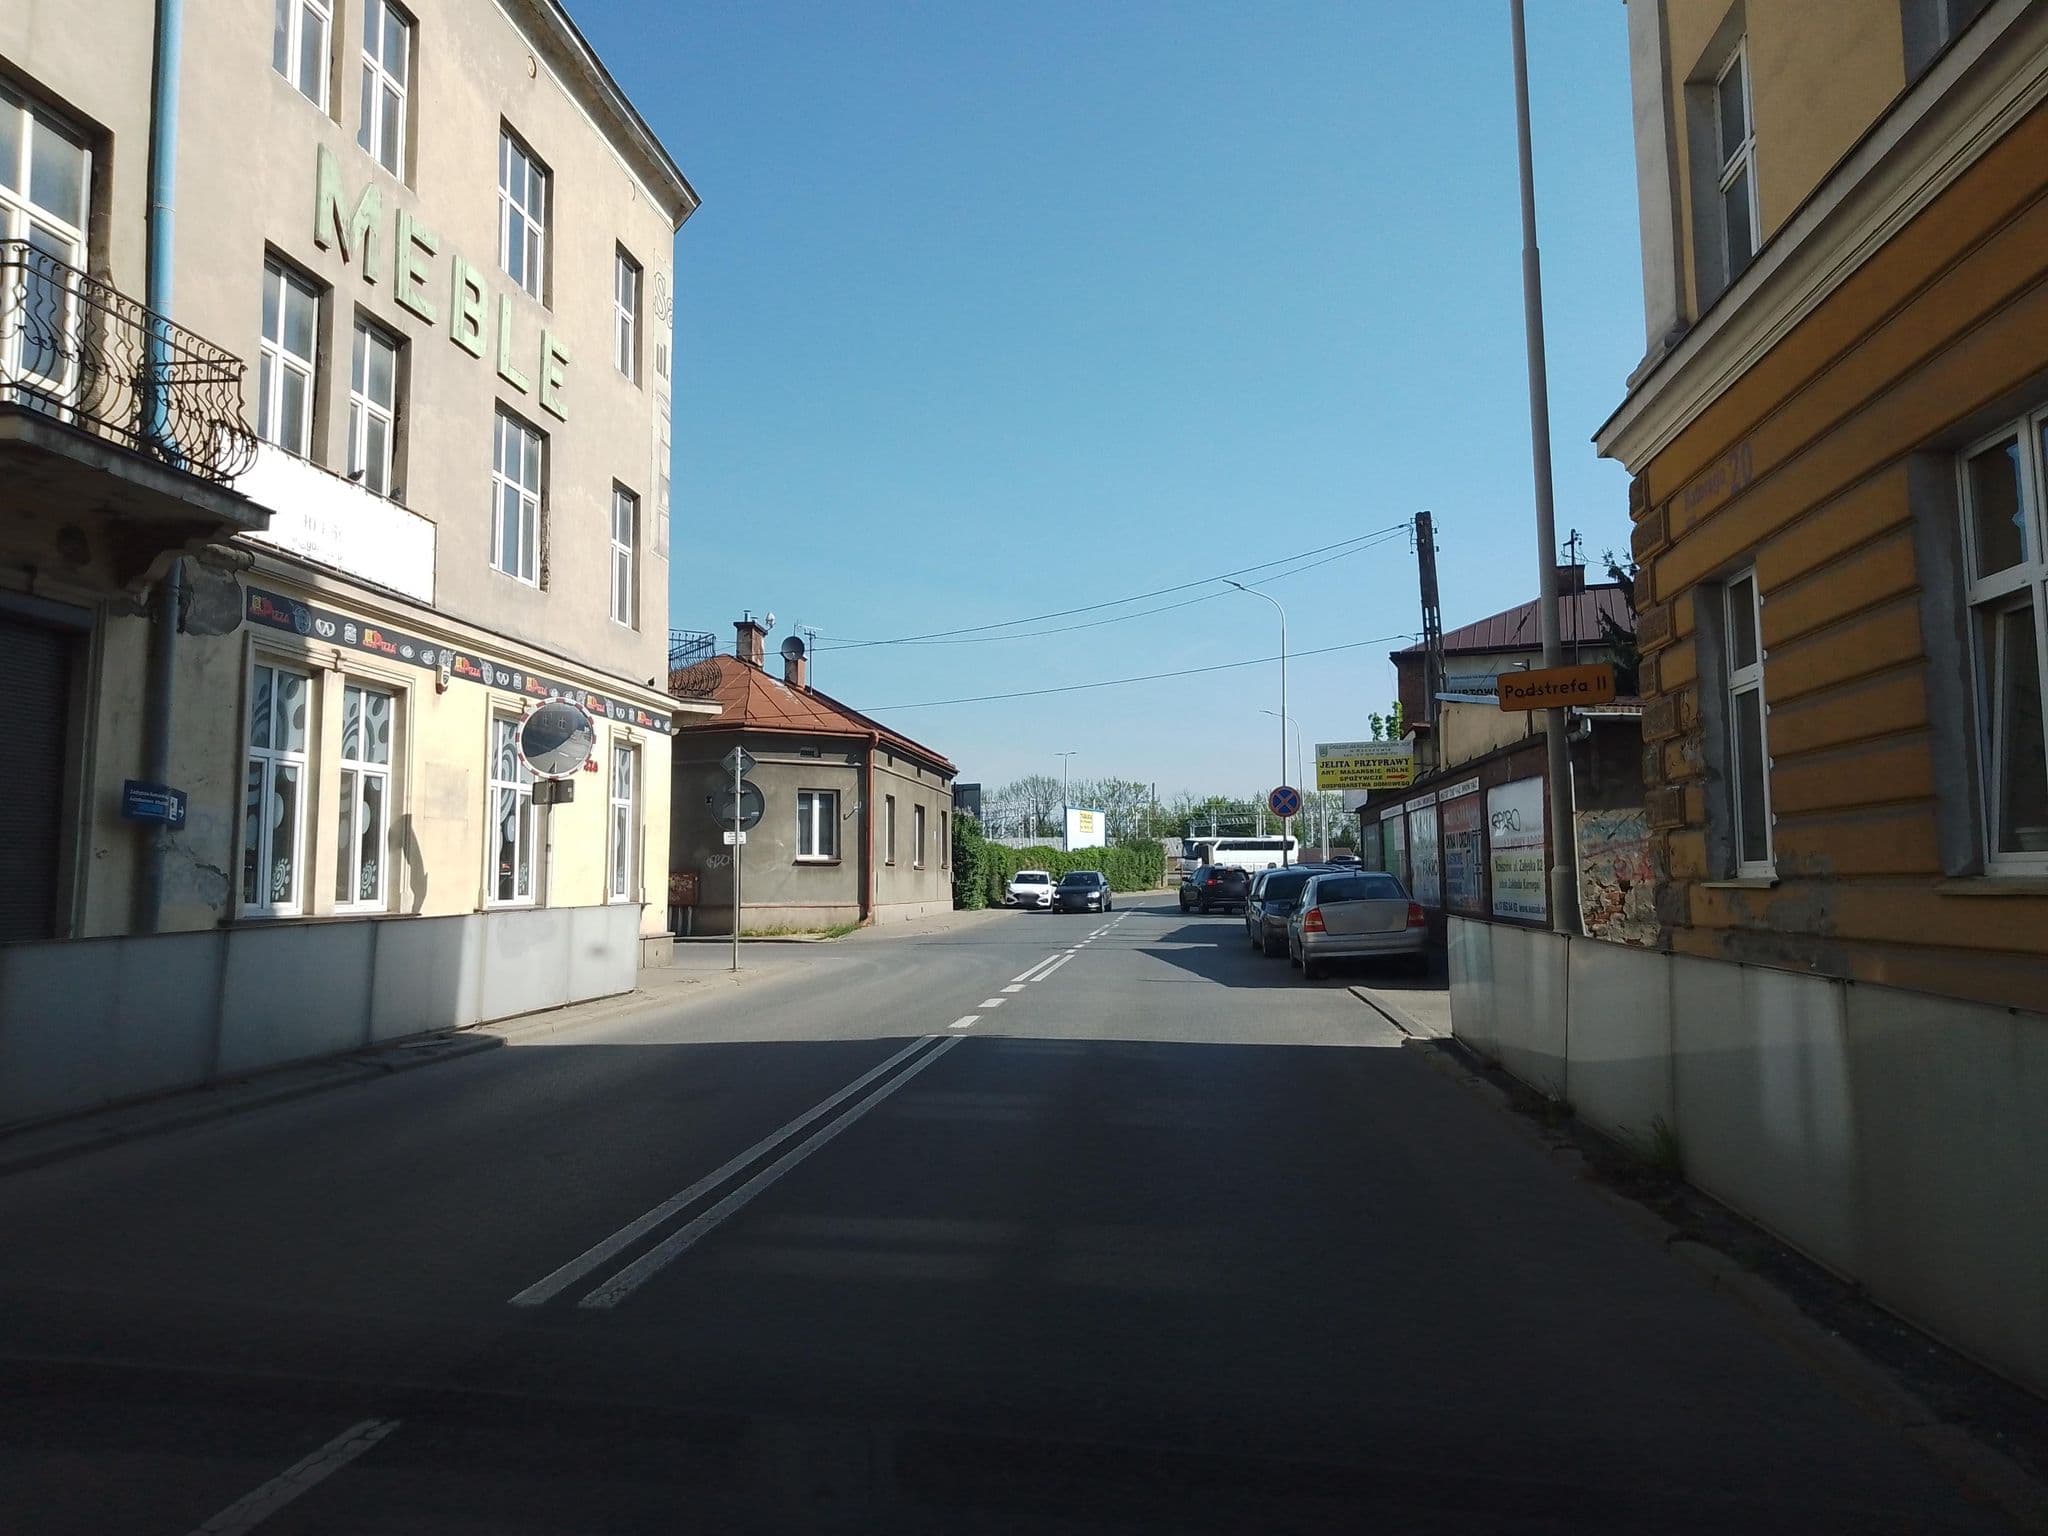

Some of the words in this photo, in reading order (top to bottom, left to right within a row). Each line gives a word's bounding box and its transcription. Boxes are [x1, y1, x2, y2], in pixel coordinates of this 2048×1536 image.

[314, 143, 569, 423] MEBLE
[1505, 679, 1588, 699] Podstrefa
[1597, 676, 1607, 691] II
[1320, 760, 1350, 769] JELITA
[1354, 758, 1410, 767] PRZYPRAWY
